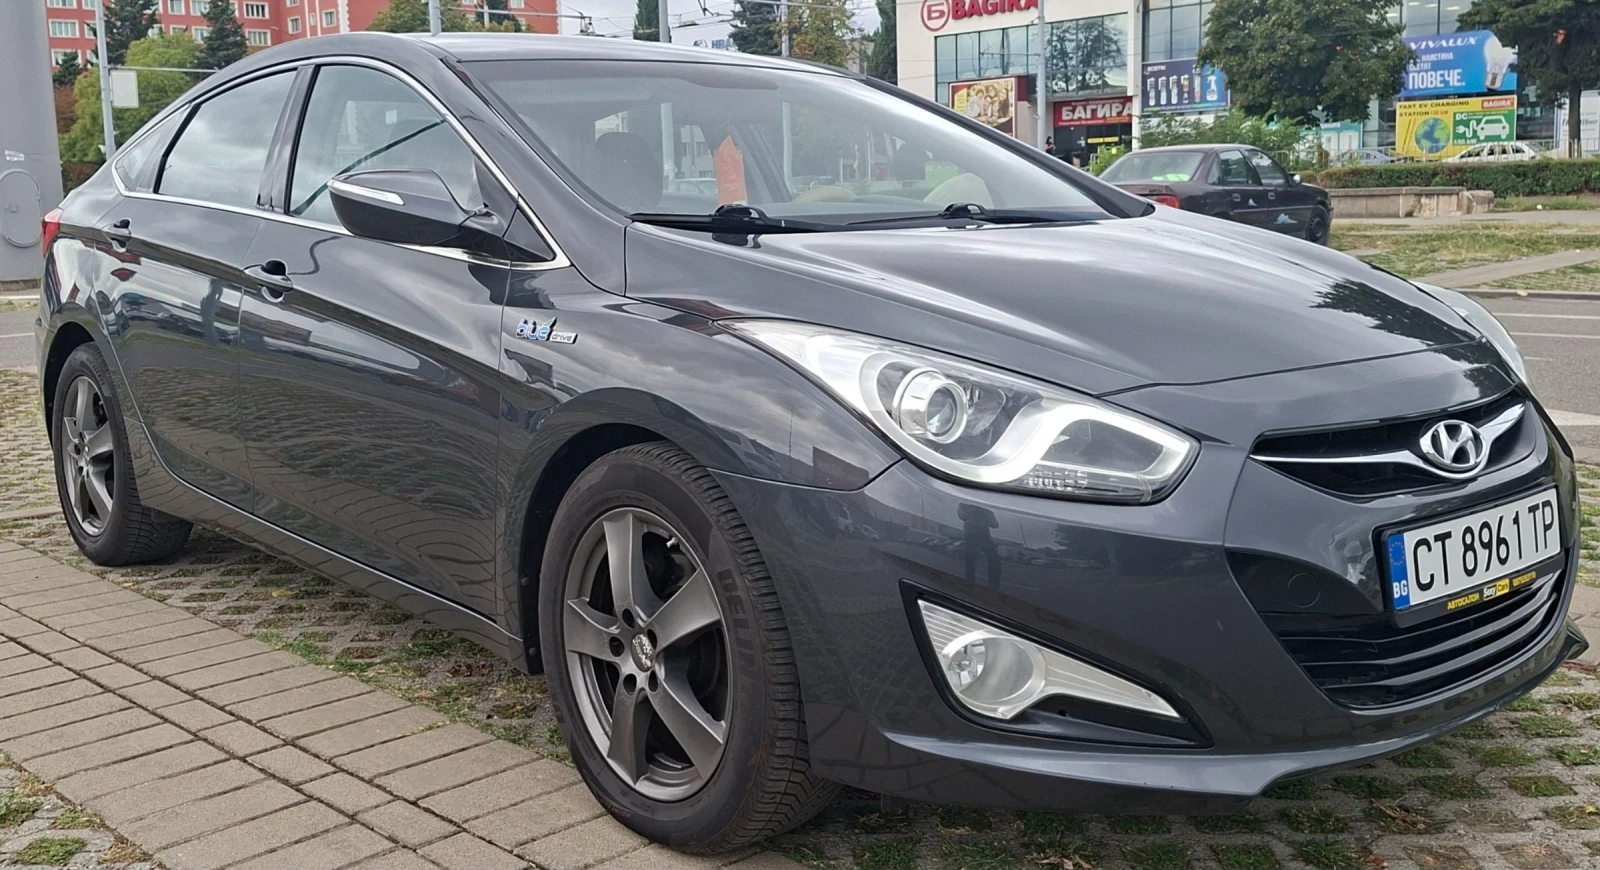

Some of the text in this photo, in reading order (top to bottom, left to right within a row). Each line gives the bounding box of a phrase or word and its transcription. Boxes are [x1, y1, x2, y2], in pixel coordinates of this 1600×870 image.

[1409, 36, 1478, 50] VIVALUX
[1409, 69, 1466, 90] ПОВЕЧЕ.
[1061, 102, 1132, 121] БАГИРА
[1430, 100, 1470, 108] CHARGING
[1483, 99, 1511, 109] BAGIRA
[1455, 113, 1468, 121] DC
[516, 318, 573, 342] blue drive
[1412, 498, 1555, 592] CT 8961 TP
[1393, 578, 1408, 599] BG
[1497, 582, 1509, 593] Cars
